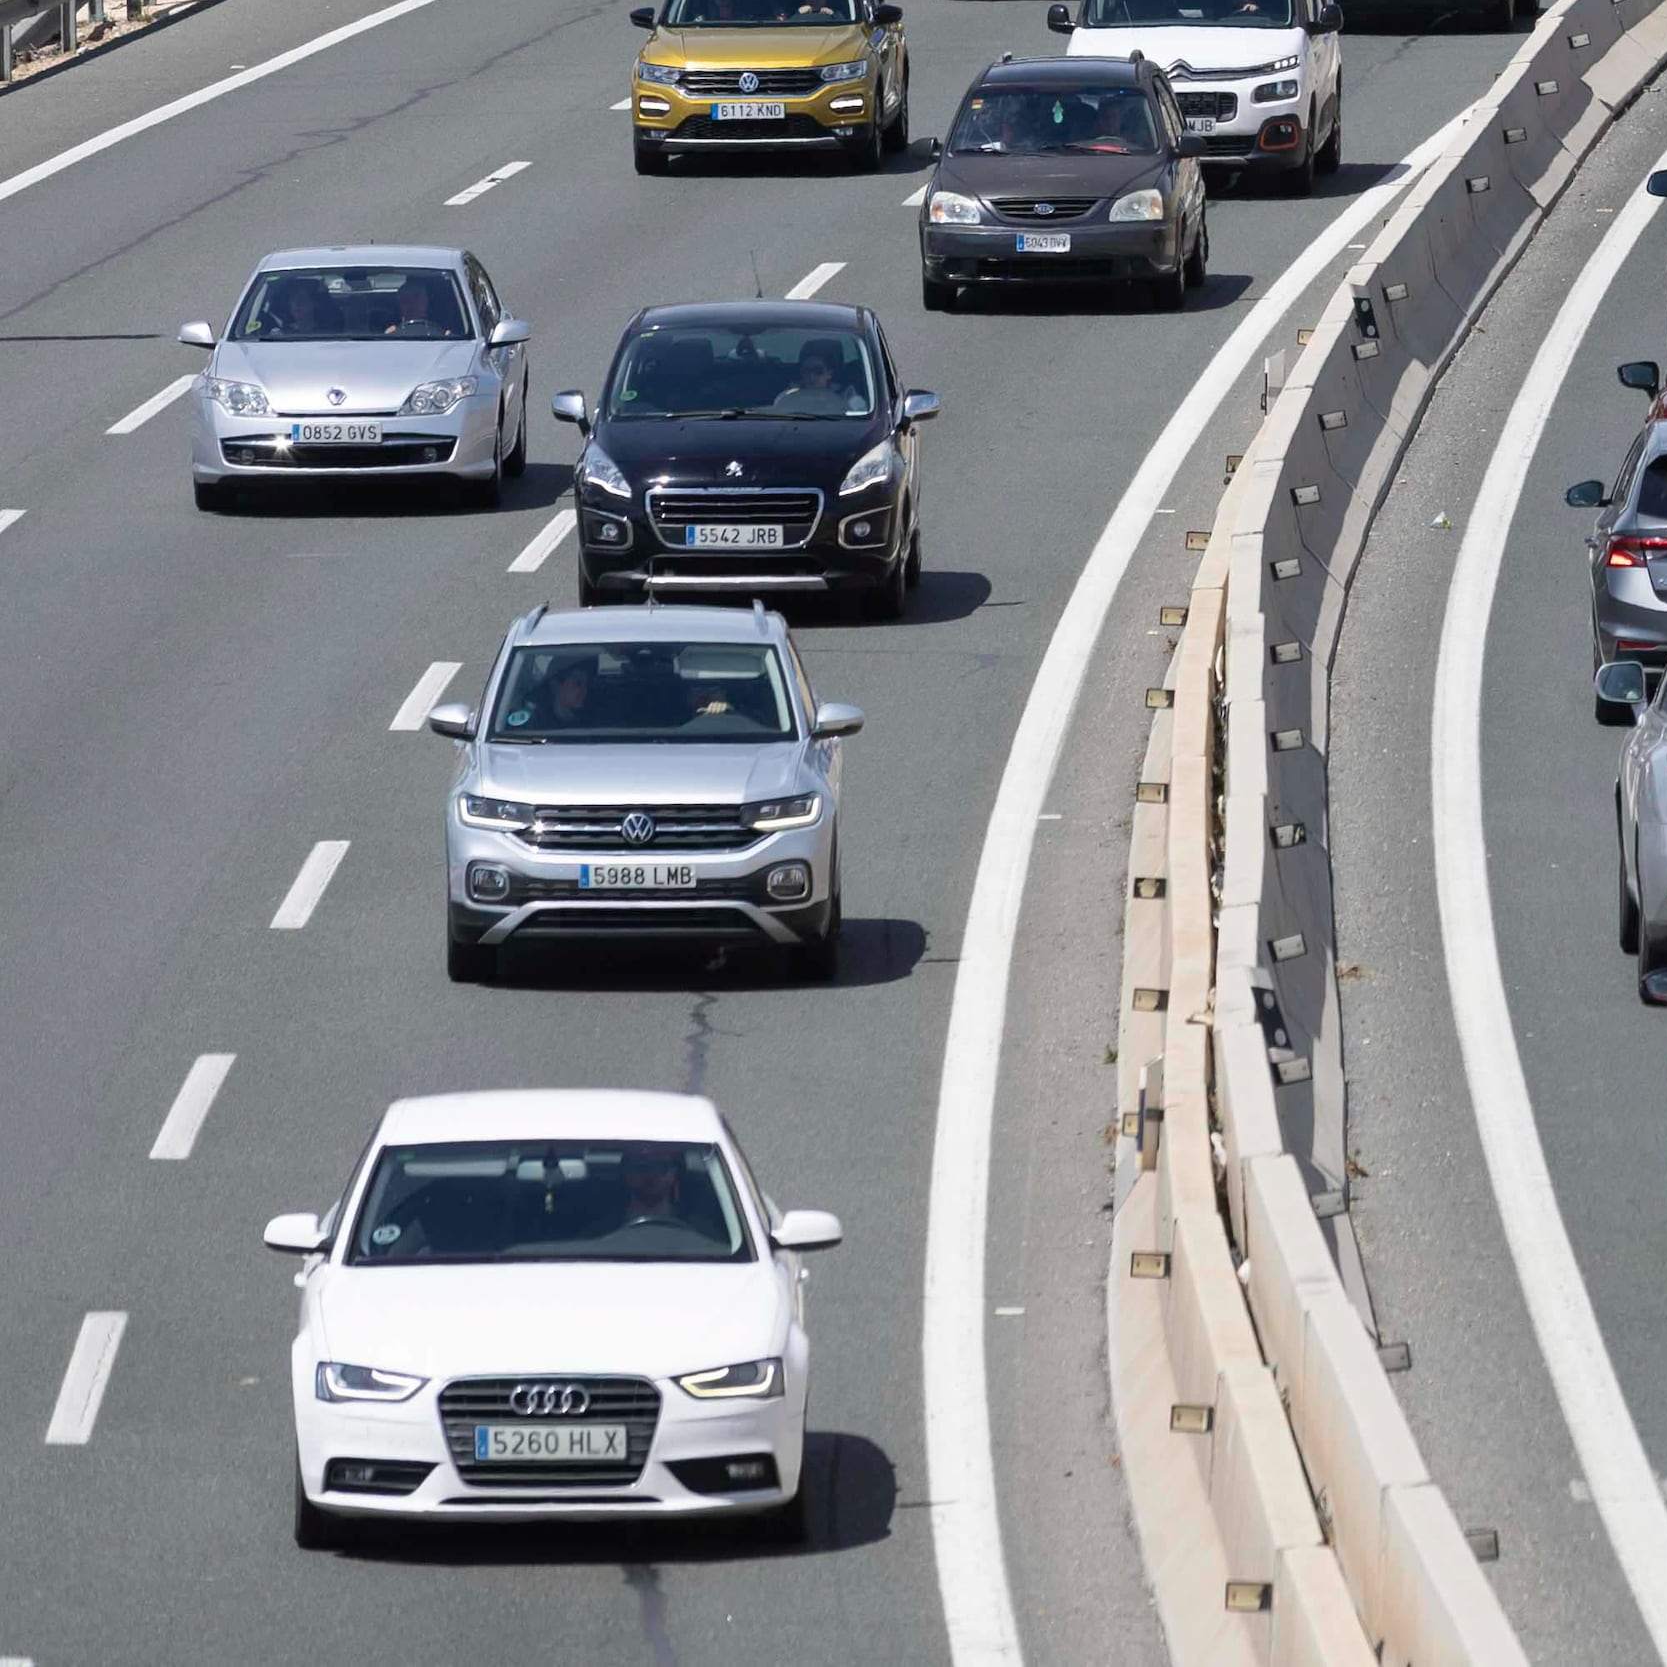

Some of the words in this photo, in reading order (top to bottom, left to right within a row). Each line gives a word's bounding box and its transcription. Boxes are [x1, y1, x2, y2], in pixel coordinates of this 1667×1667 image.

[720, 105, 753, 118] 6112
[757, 104, 782, 117] KND
[303, 426, 343, 441] 0852
[348, 424, 378, 440] GVS
[699, 528, 740, 544] 5542
[747, 528, 778, 544] JRB
[593, 867, 646, 885] 5988
[653, 866, 694, 885] LMB
[493, 1430, 560, 1455] 5260
[568, 1430, 618, 1455] HLX
